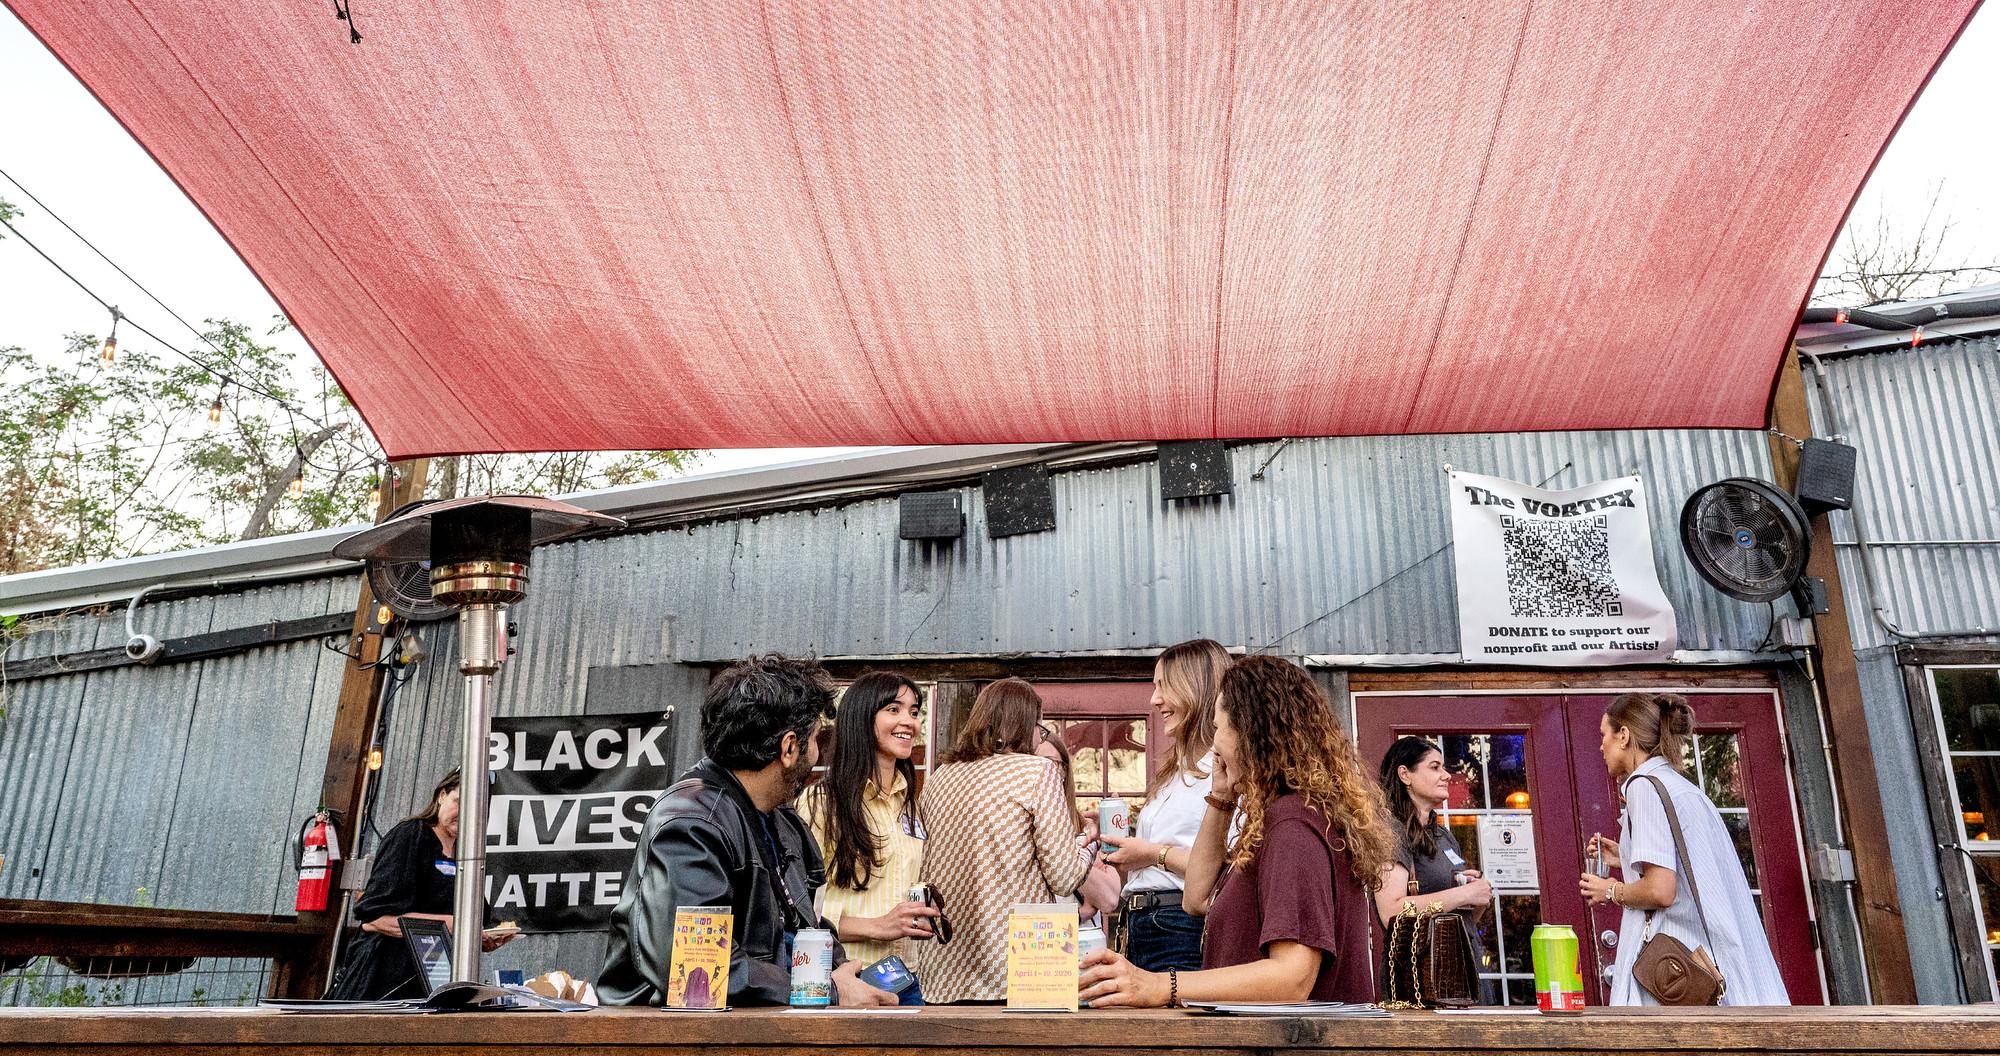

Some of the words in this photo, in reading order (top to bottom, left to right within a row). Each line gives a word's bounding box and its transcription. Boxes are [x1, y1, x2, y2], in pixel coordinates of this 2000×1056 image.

[1465, 486, 1515, 509] The
[1521, 488, 1635, 518] VORTEX
[1484, 643, 1548, 656] nonprofit
[1552, 641, 1577, 652] and
[1581, 643, 1605, 651] our
[1608, 640, 1660, 651] Artists!
[1488, 626, 1548, 637] DONATE
[1552, 627, 1566, 637] to
[1570, 626, 1623, 638] support
[1626, 626, 1651, 636] our
[488, 725, 669, 772] BLACK
[485, 871, 623, 908] ATTE
